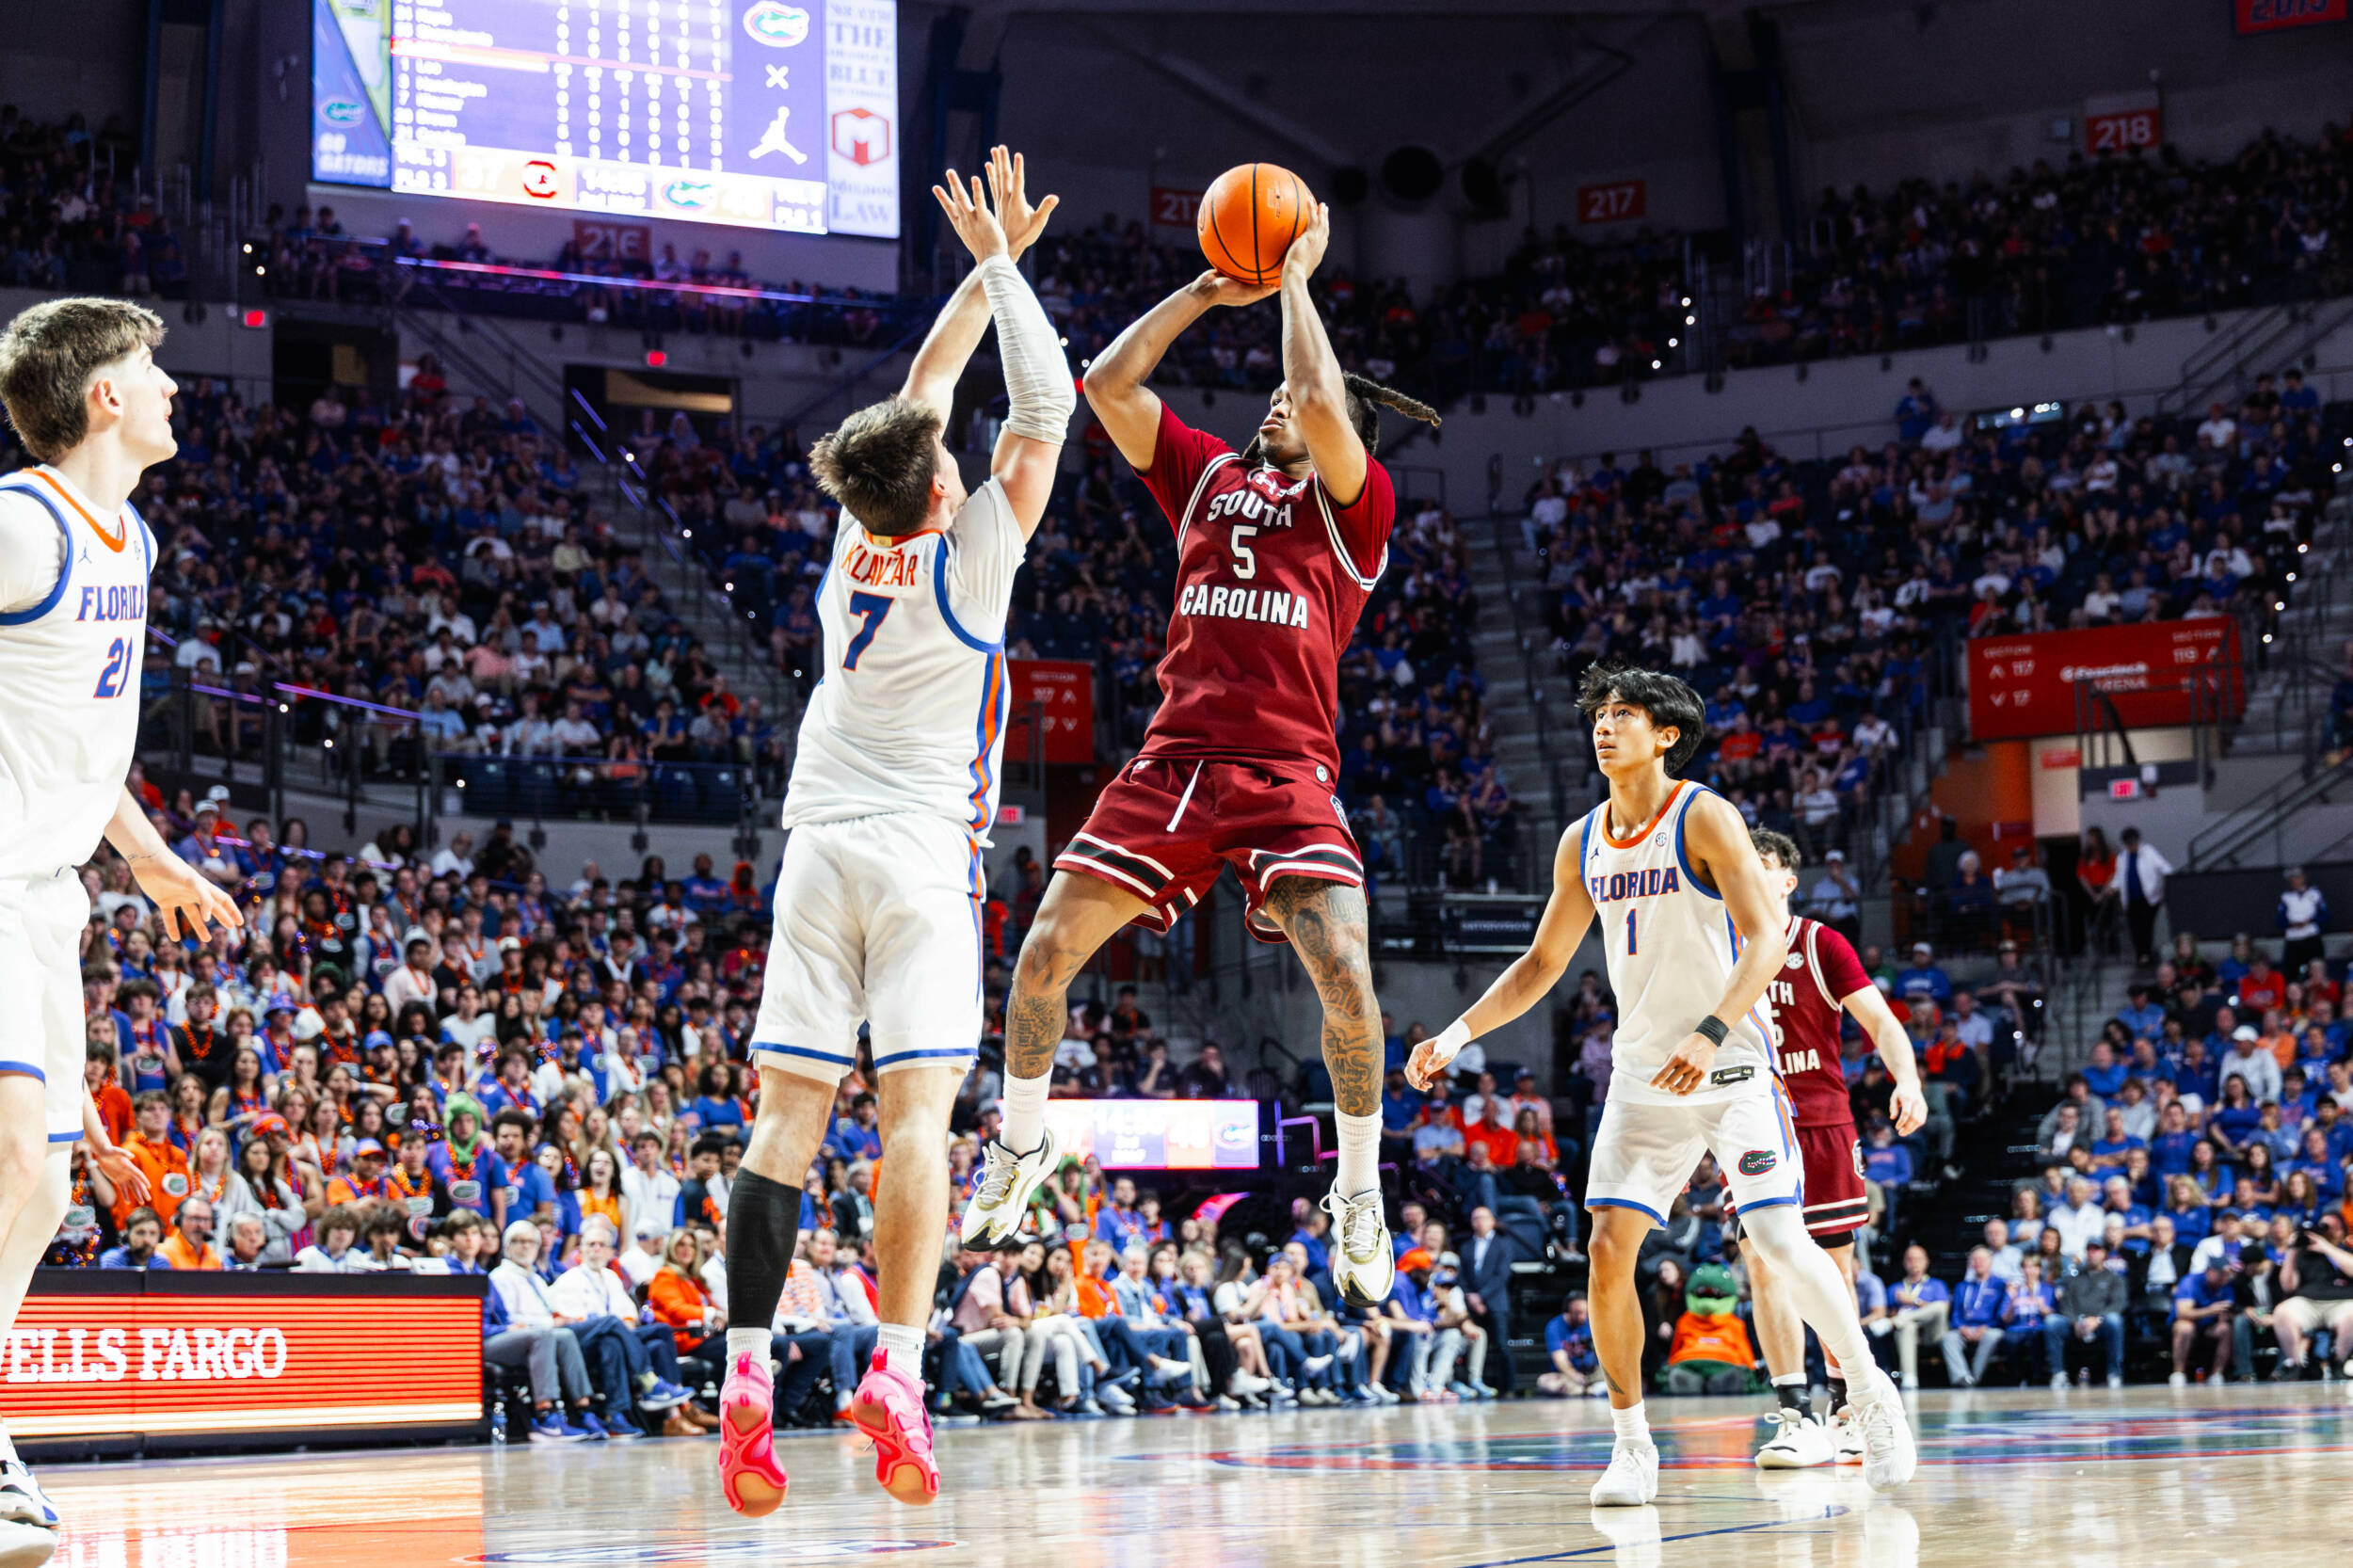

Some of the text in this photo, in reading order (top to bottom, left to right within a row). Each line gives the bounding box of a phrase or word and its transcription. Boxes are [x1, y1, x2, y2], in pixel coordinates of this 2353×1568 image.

[2095, 116, 2151, 148] 218
[318, 154, 389, 177] GATORS
[1588, 186, 1636, 217] 217
[582, 226, 641, 259] 216
[1207, 489, 1292, 528] SOUTH
[1230, 523, 1258, 580] 5
[1179, 584, 1308, 630] CAROLINA
[840, 589, 896, 673] 7
[92, 635, 134, 699] 21
[1590, 866, 1680, 904] FLORIDA
[1625, 907, 1638, 956] 1
[0, 1328, 287, 1383] ELLS FARGO
